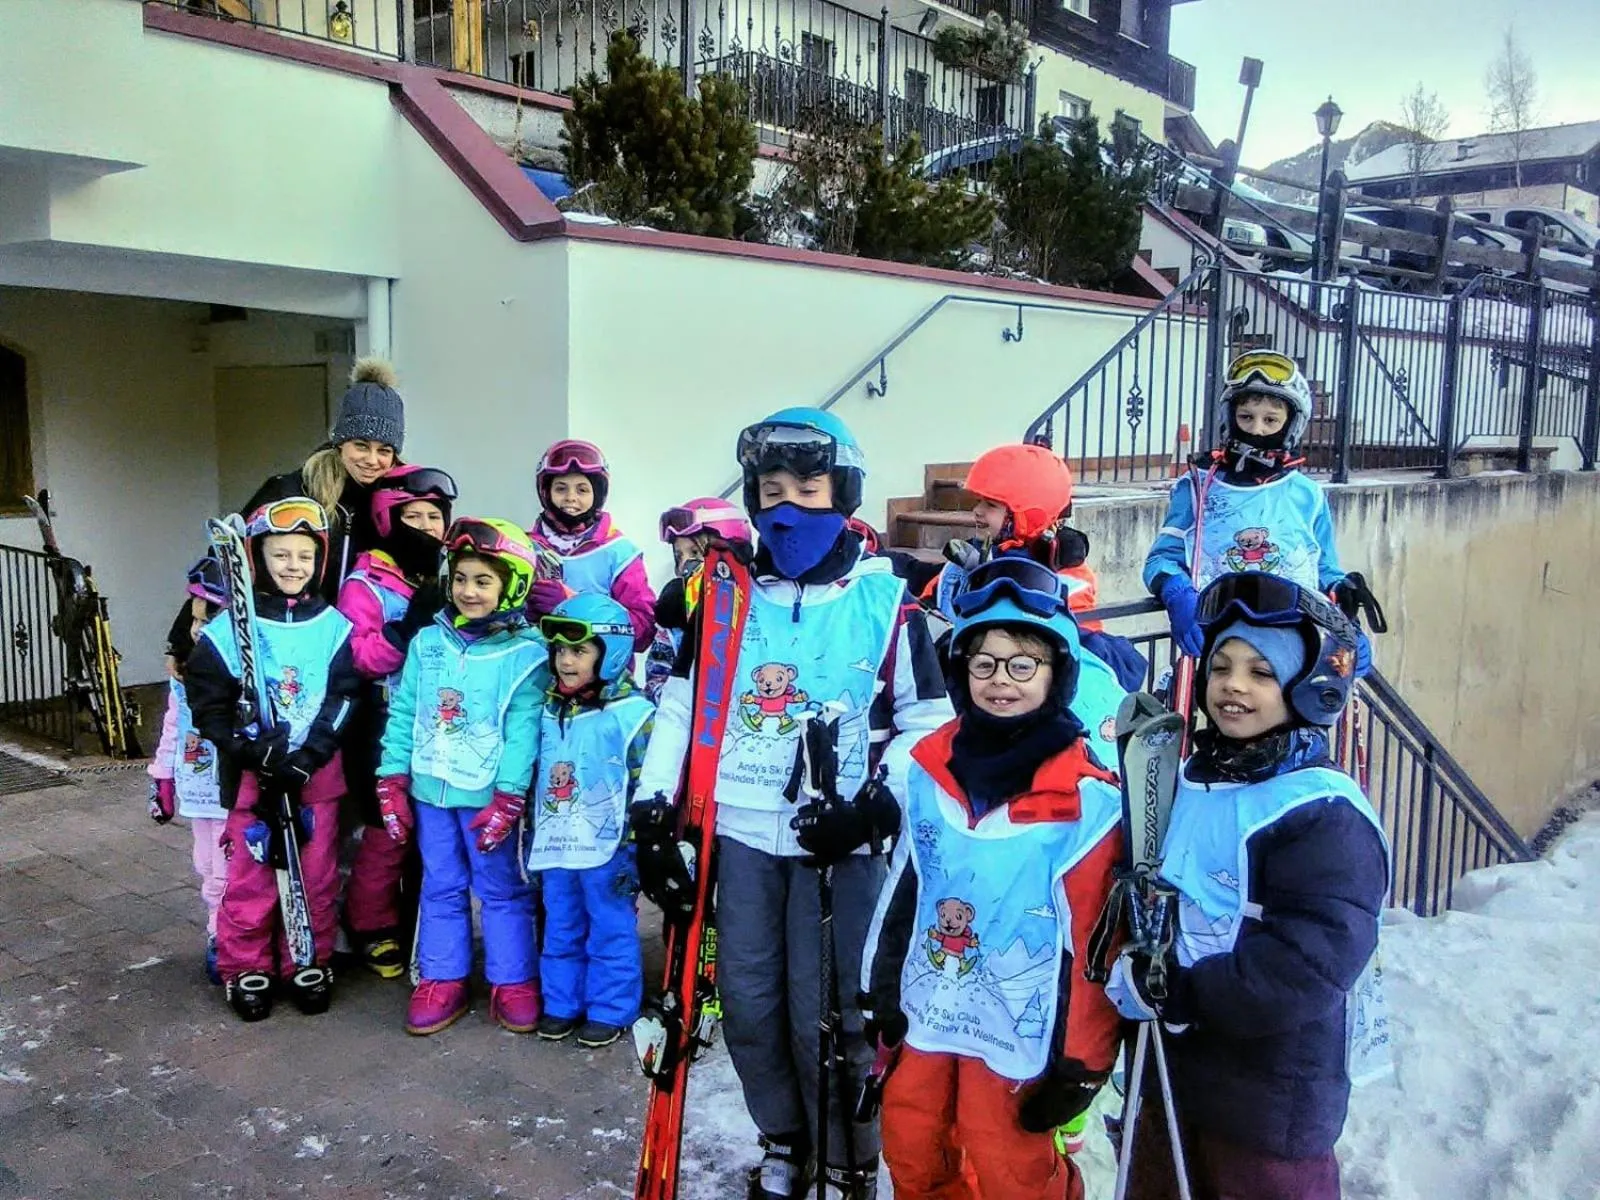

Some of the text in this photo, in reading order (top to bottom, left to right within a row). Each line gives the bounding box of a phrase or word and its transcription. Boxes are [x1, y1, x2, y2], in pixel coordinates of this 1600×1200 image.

[229, 535, 257, 698] DYNASTAR
[699, 582, 734, 748] HEAD
[737, 761, 767, 774] Andy's
[1144, 755, 1160, 860] DYNASTAR
[941, 1008, 955, 1022] Ski
[957, 1011, 981, 1026] Club
[962, 1024, 970, 1035] &
[973, 1026, 1016, 1053] Wellness
